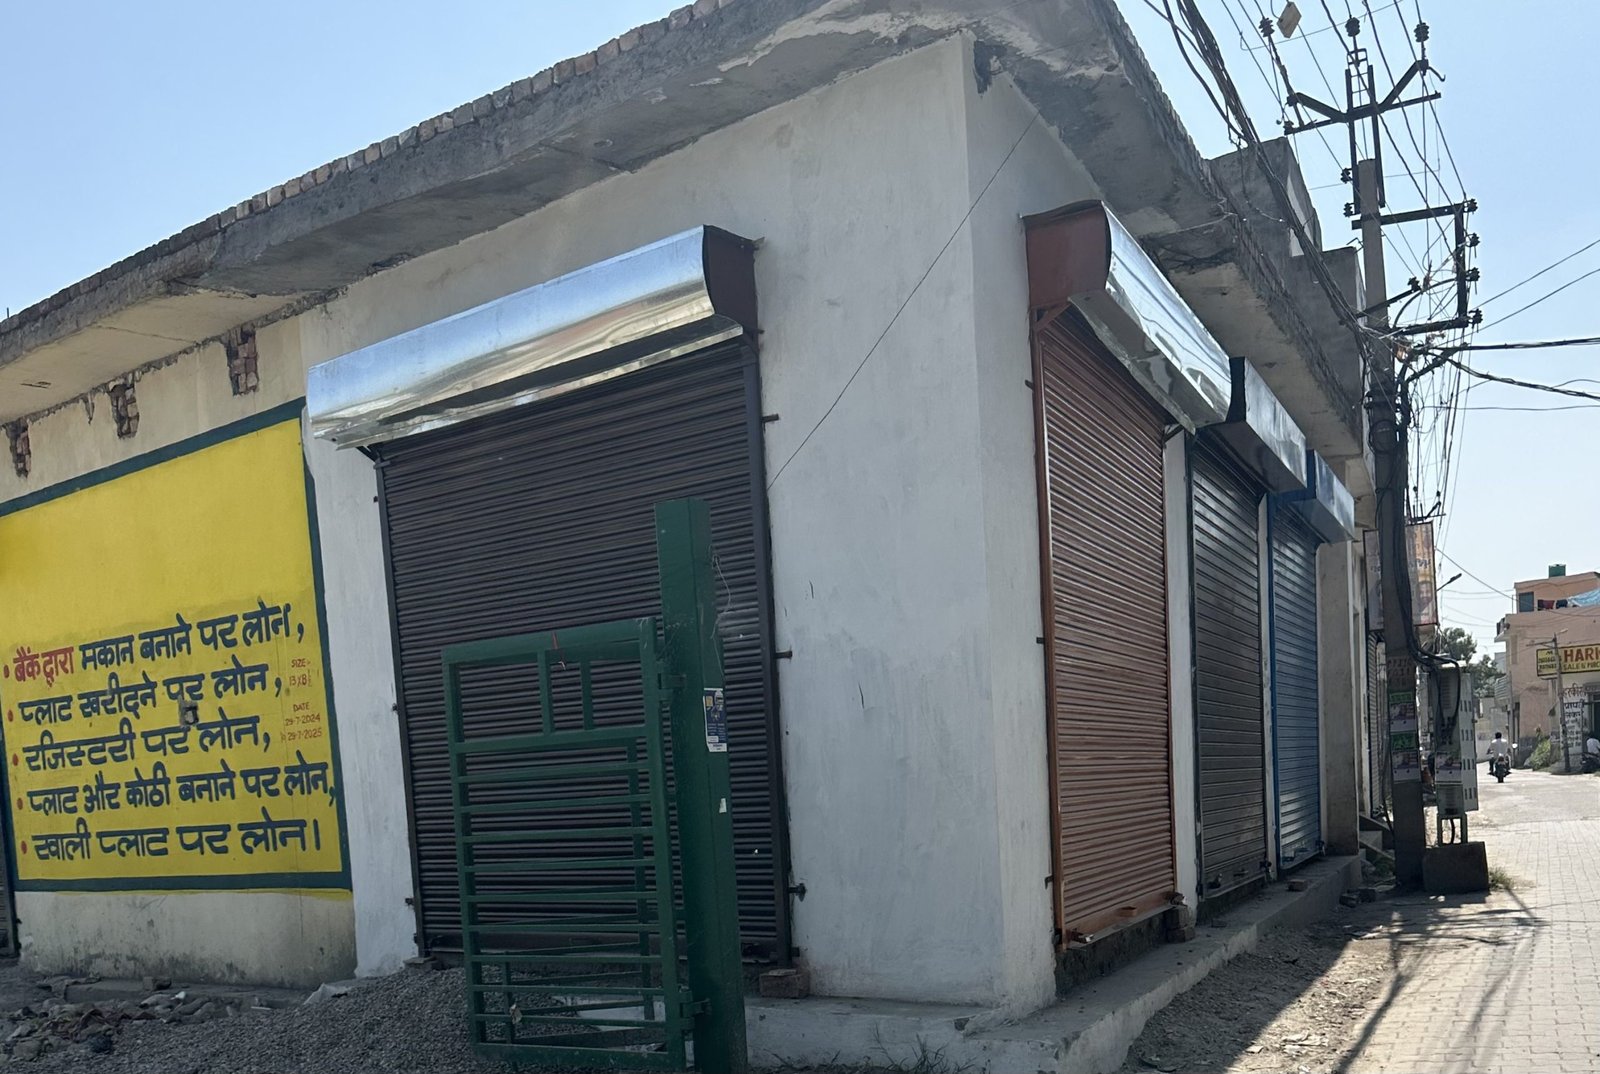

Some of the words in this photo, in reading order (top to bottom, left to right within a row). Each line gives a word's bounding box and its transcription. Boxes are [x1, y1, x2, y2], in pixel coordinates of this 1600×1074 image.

[79, 634, 134, 671] मकान
[138, 613, 192, 661] बनाने
[197, 614, 238, 650] पर
[18, 695, 73, 725] प्लाट
[78, 671, 157, 719] खरीदने
[163, 673, 205, 701] पर
[293, 701, 310, 712] DATE
[141, 725, 191, 757] पर
[26, 786, 79, 816] प्लाट
[82, 770, 121, 813] और
[125, 761, 170, 807] कोठी
[176, 758, 236, 803] बनाने
[240, 767, 280, 798] पर
[31, 817, 91, 861] खाली
[96, 828, 169, 857] प्लाट
[176, 824, 231, 855] पर
